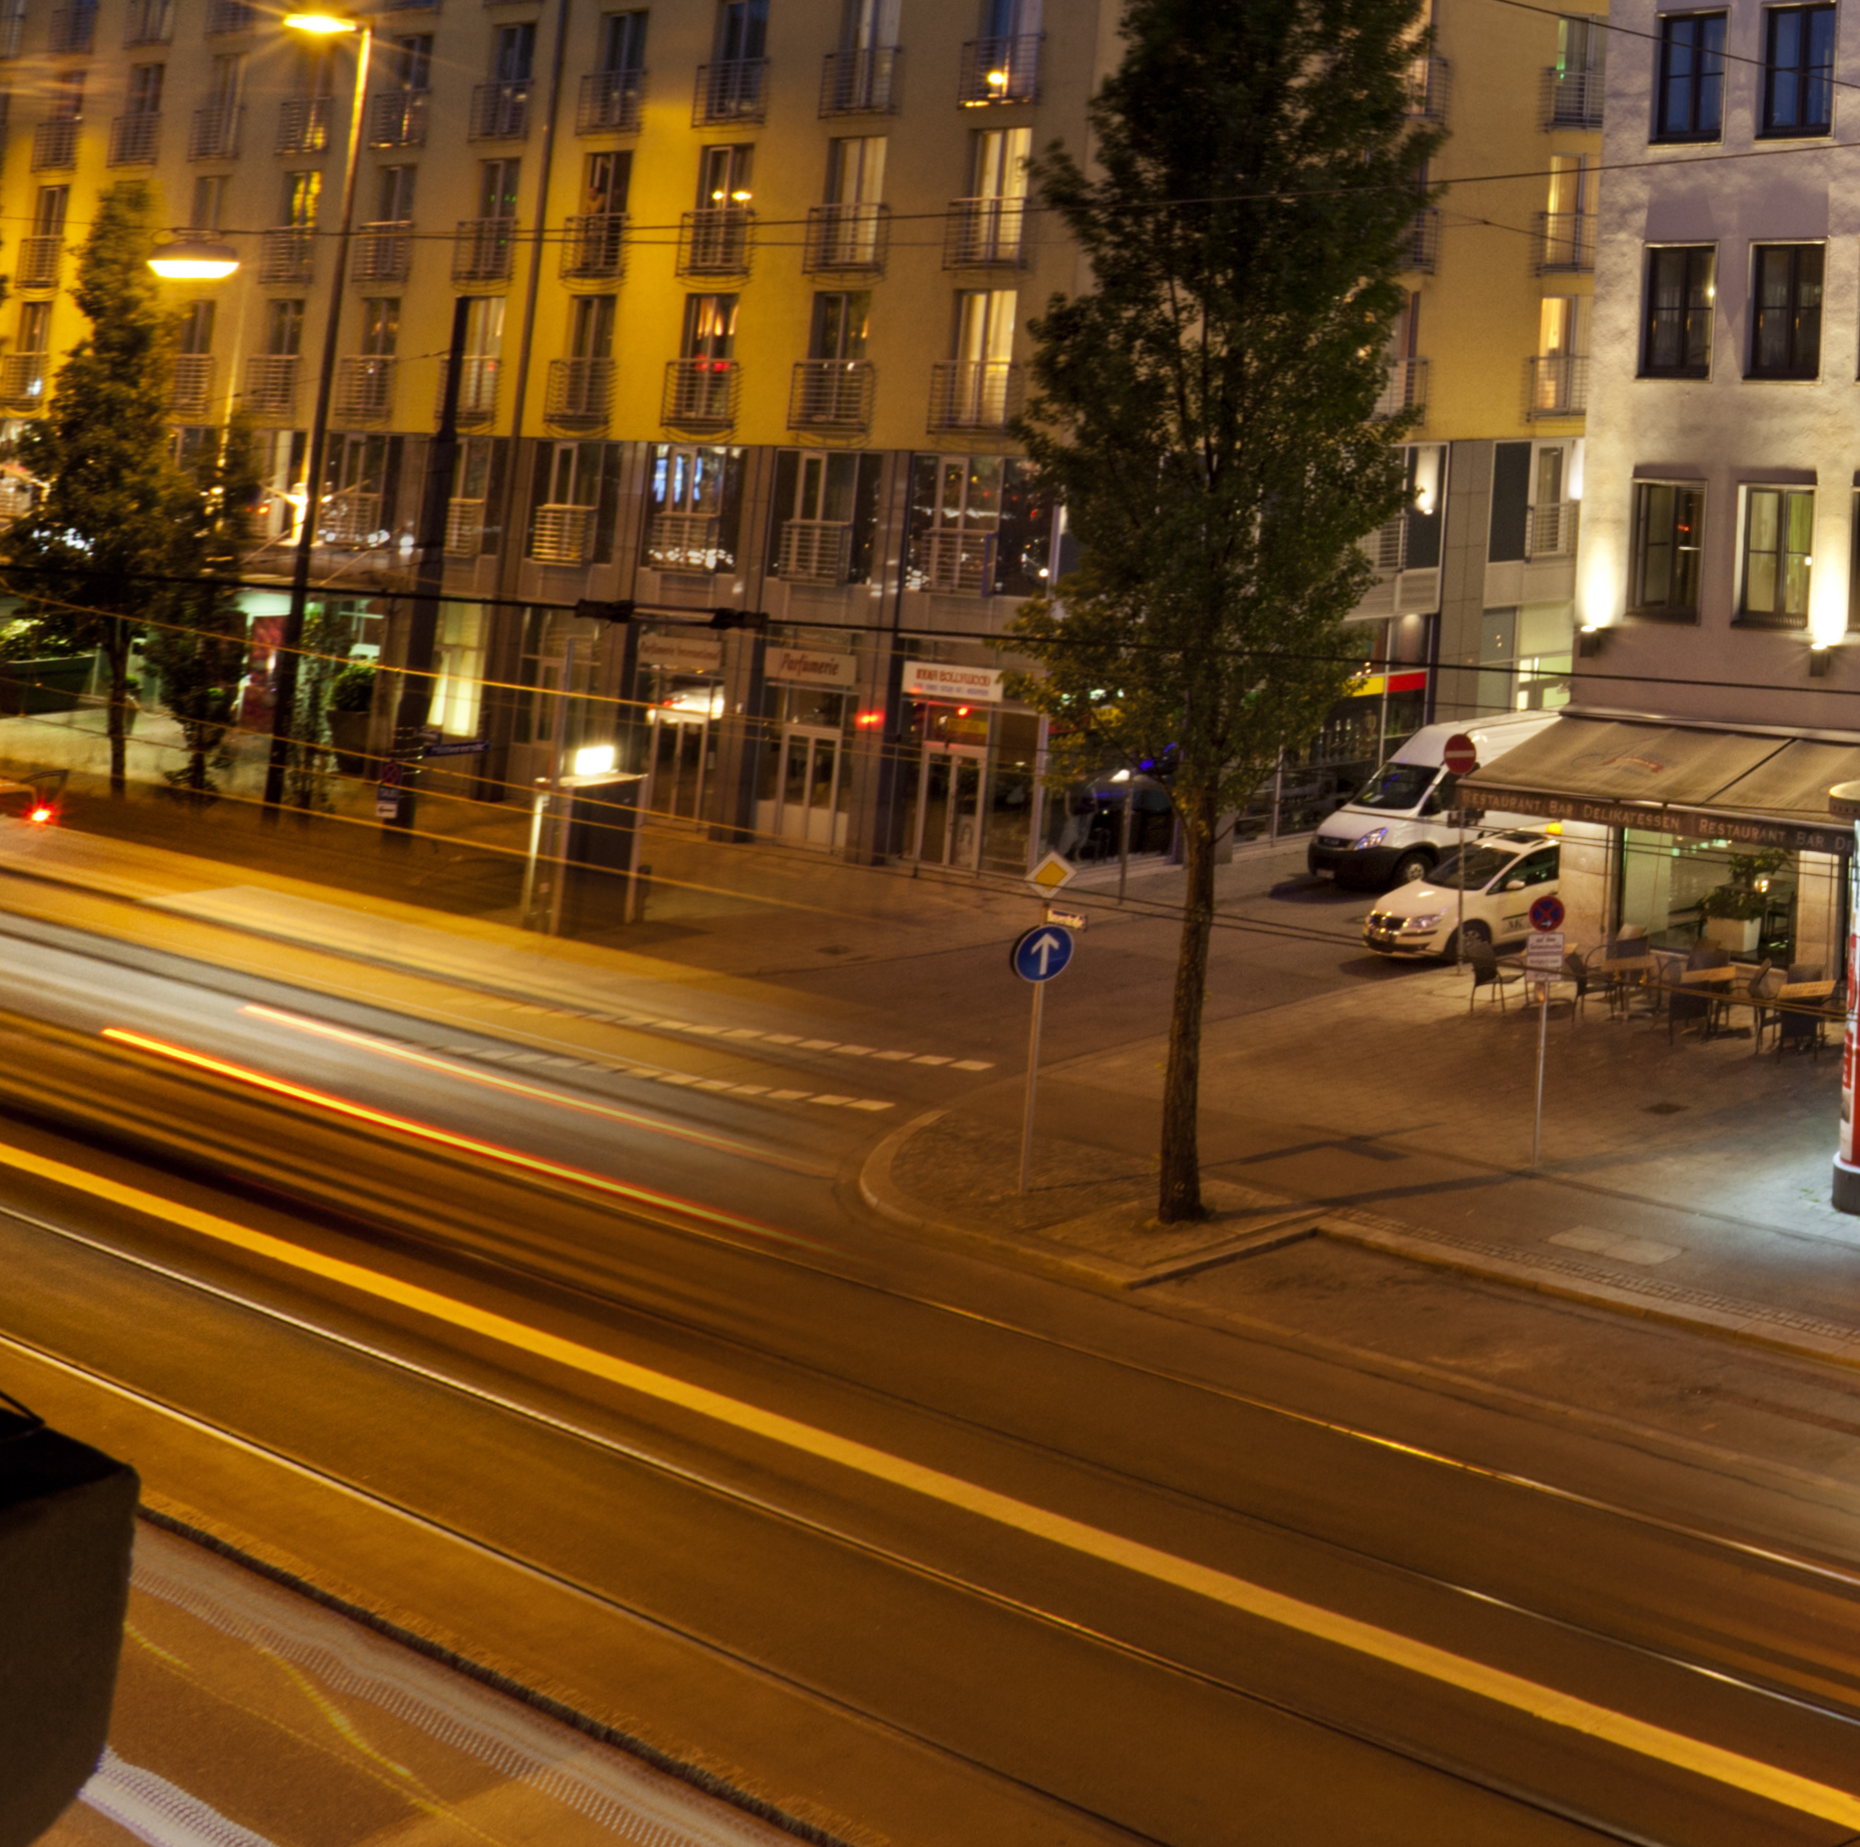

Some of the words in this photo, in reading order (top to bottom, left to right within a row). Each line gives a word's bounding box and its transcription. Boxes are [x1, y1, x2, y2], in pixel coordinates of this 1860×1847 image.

[1462, 789, 1541, 812] RESTAURANT
[1550, 801, 1574, 817] BAR
[1583, 805, 1680, 829] DELIKATESSEN
[1699, 819, 1786, 842] RESTAURANT
[1796, 831, 1824, 848] BAR
